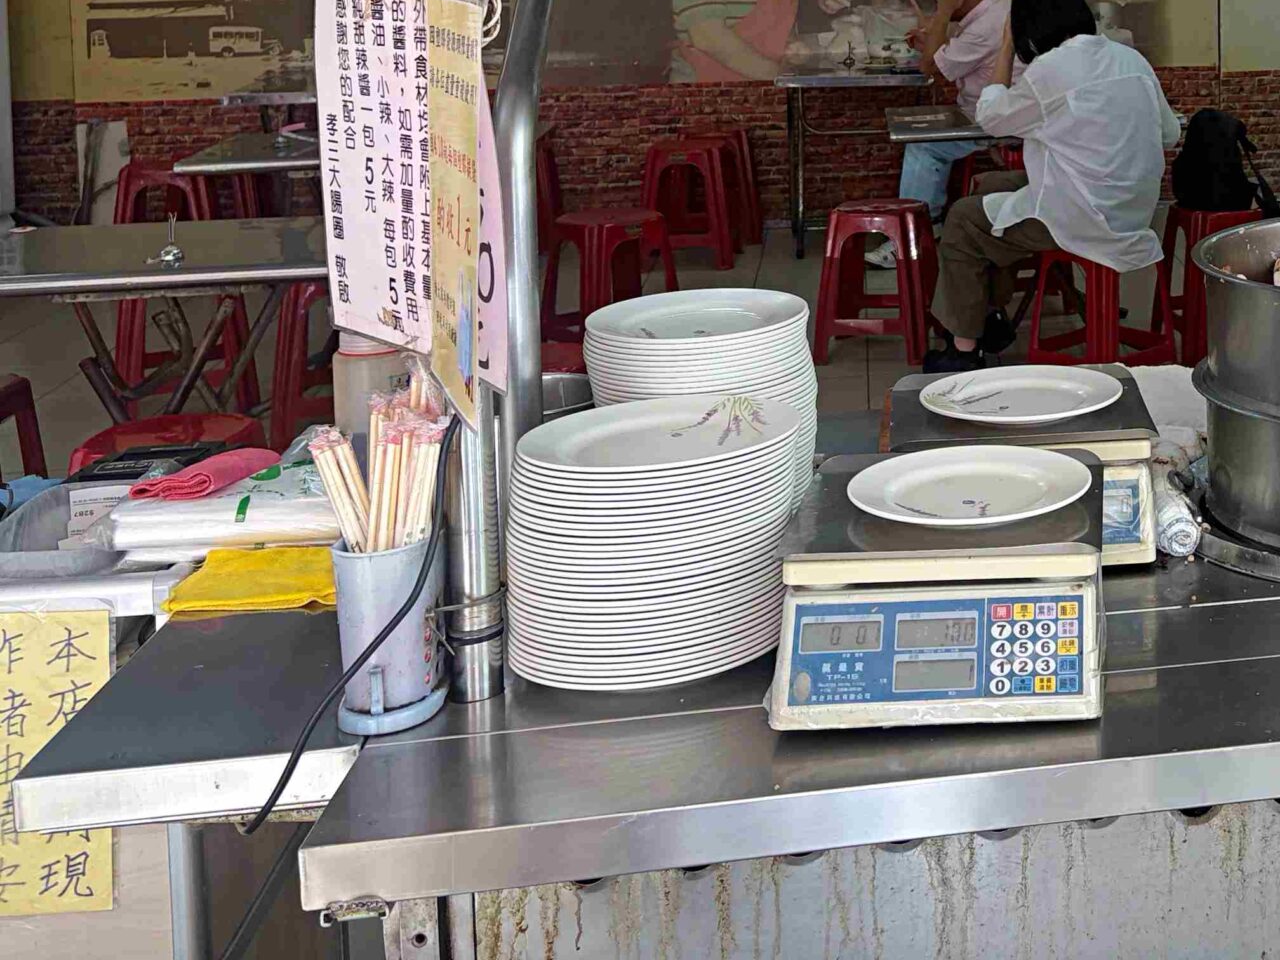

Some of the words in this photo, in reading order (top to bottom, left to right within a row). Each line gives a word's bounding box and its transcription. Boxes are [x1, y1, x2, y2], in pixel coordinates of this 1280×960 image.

[996, 624, 1007, 637] 7
[1018, 623, 1029, 636] 8
[1041, 622, 1051, 635] 9
[995, 642, 1007, 655] 4
[1018, 641, 1029, 654] 5
[1041, 641, 1051, 653] 6
[1018, 660, 1029, 673] 2
[1040, 659, 1051, 672] 3
[995, 679, 1005, 692] 0
